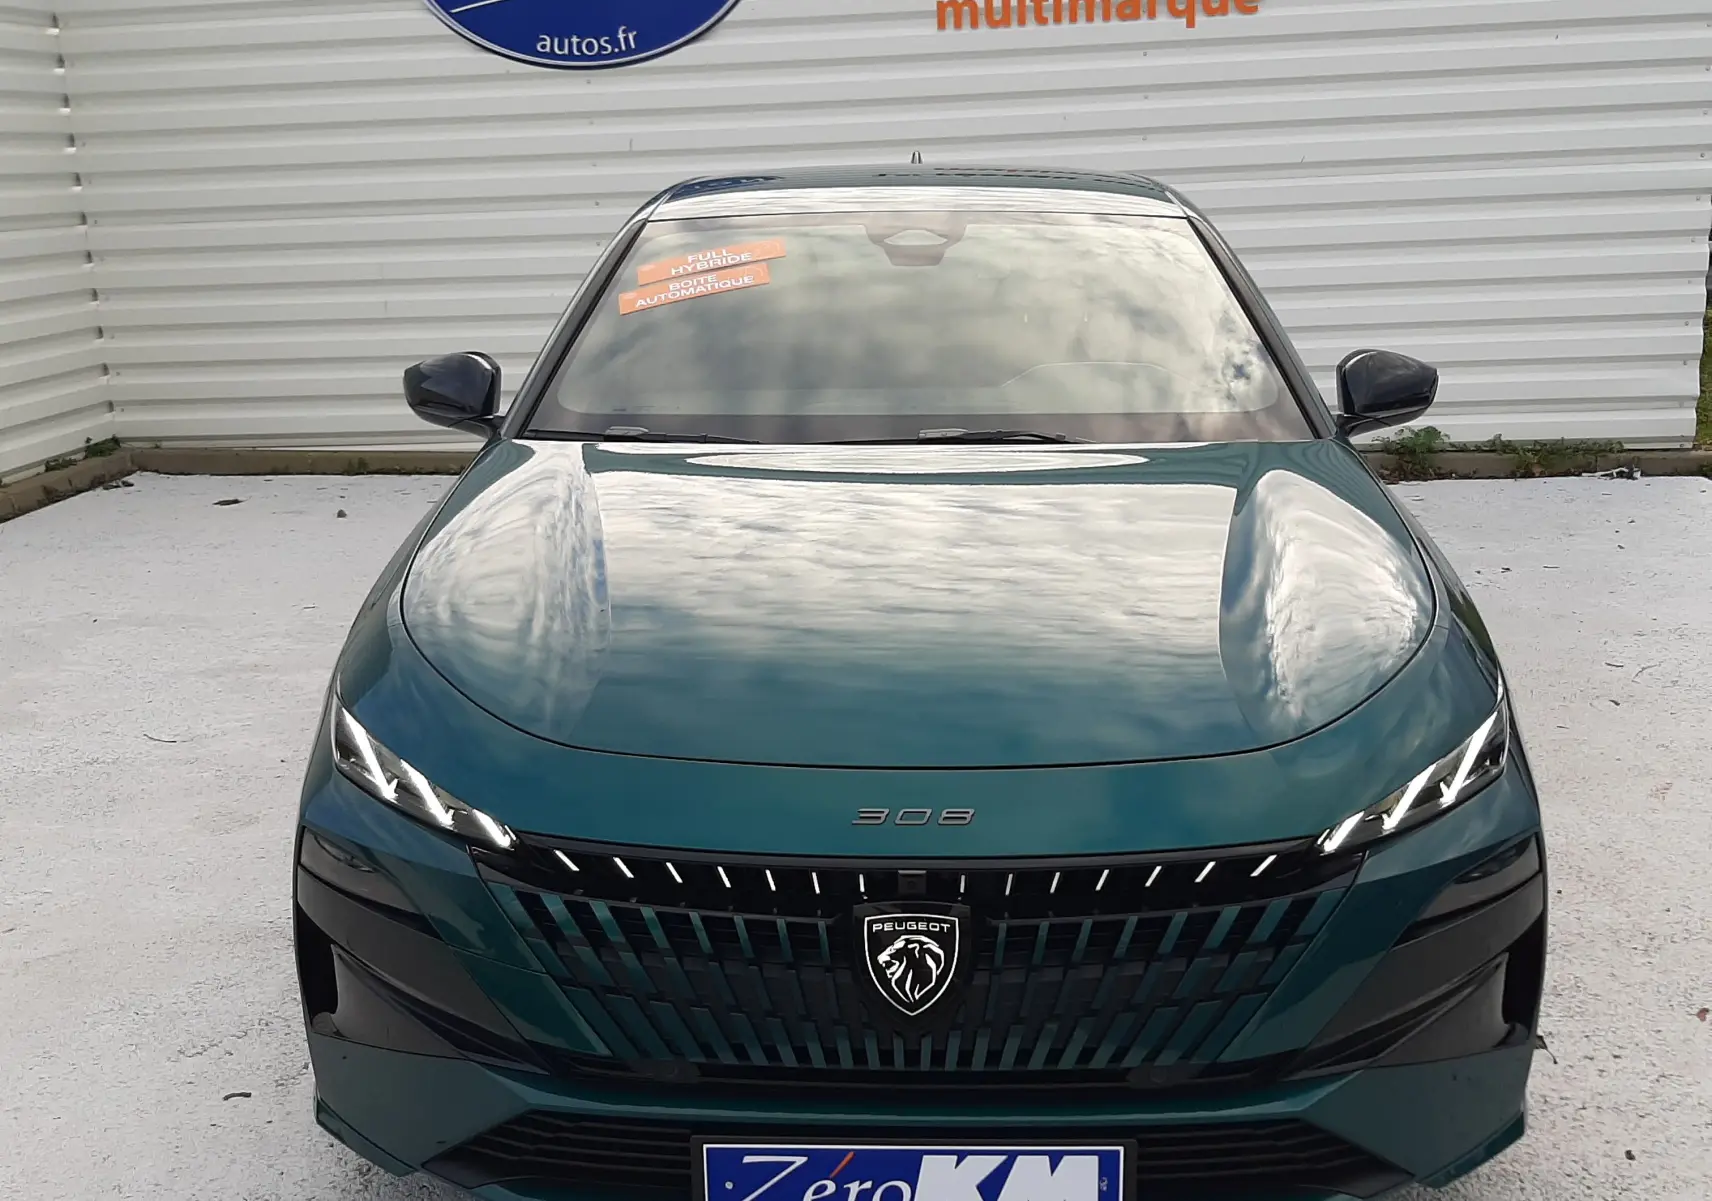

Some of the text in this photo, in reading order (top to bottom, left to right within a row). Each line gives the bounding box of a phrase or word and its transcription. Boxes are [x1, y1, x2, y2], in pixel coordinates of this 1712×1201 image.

[536, 26, 639, 57] autos.fr
[671, 252, 752, 276] HYBRIDE
[687, 248, 733, 264] FULL
[635, 275, 755, 308] AUTOMATIQUE
[668, 274, 718, 292] BOITE
[851, 807, 976, 826] 308
[872, 921, 951, 934] PEUGEOT
